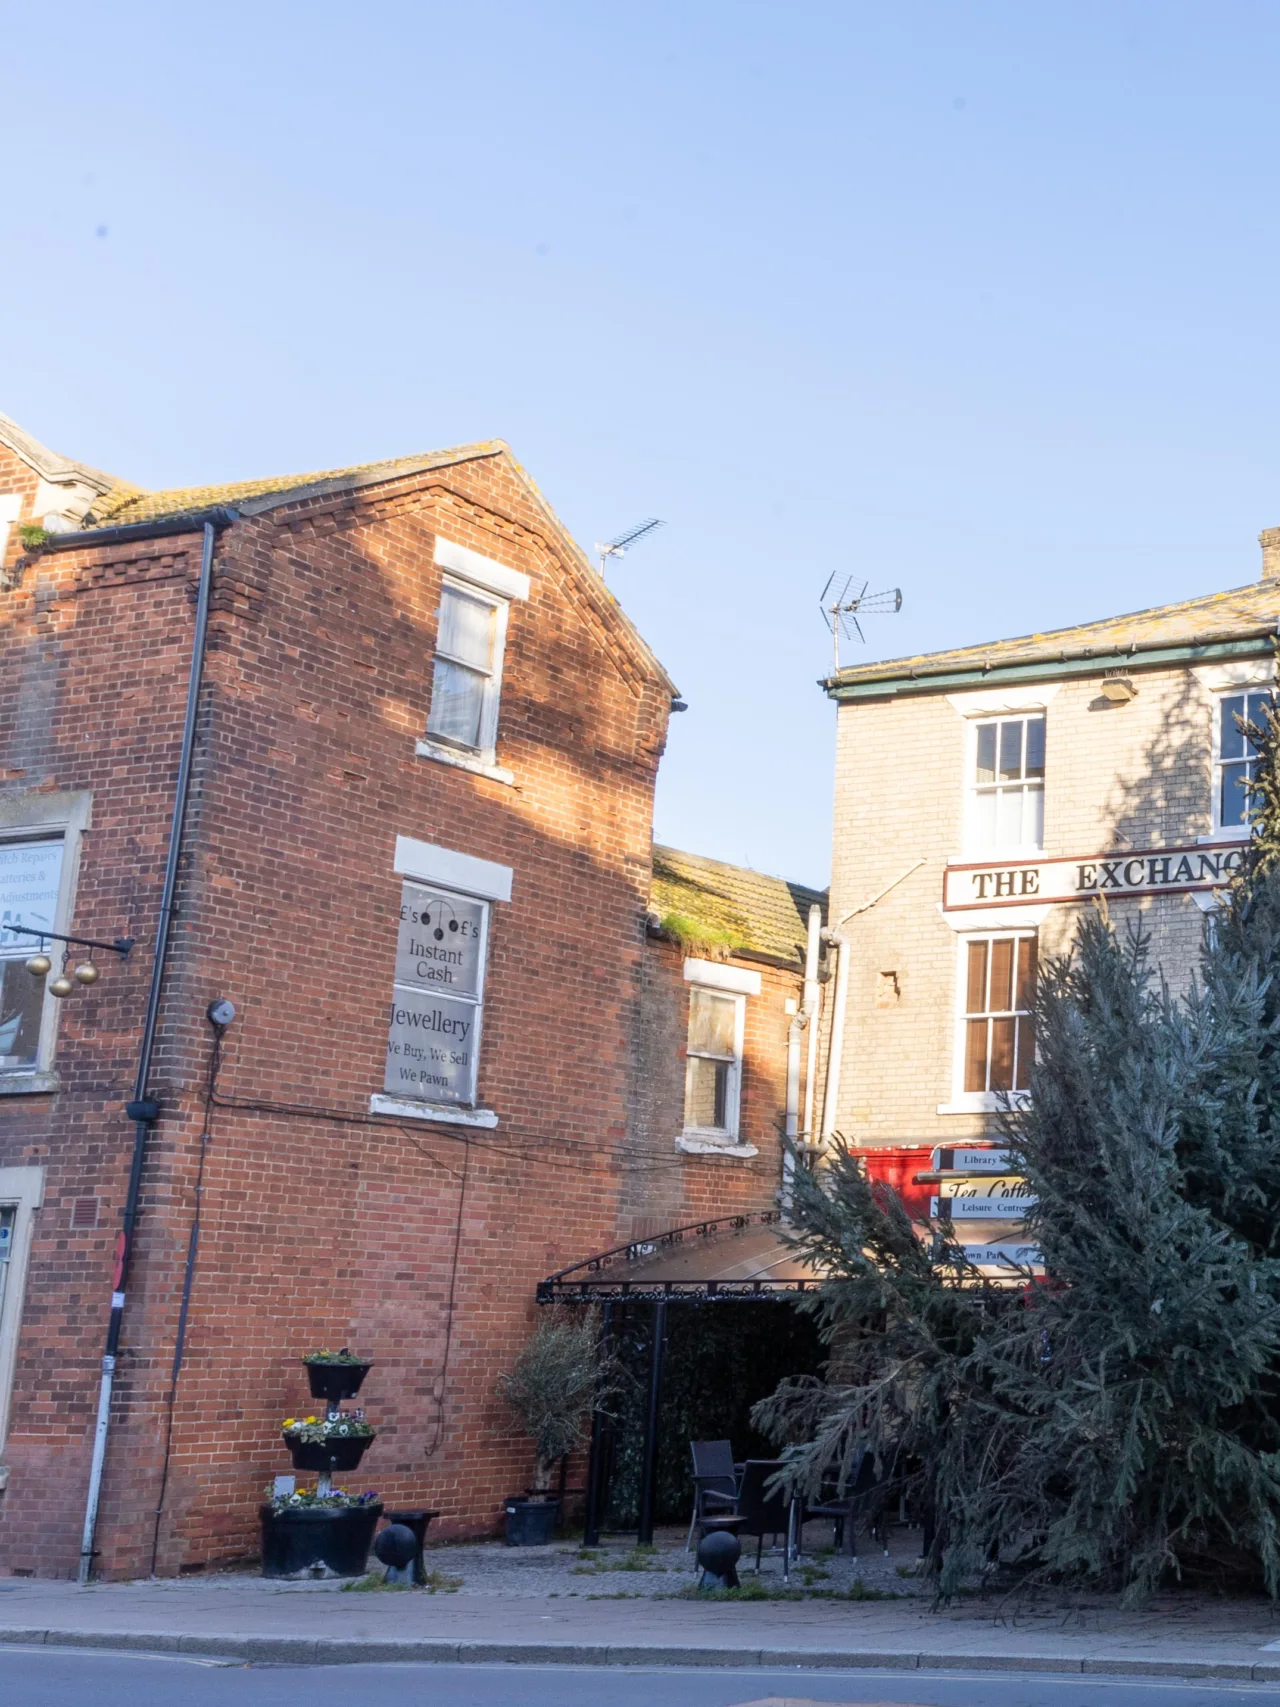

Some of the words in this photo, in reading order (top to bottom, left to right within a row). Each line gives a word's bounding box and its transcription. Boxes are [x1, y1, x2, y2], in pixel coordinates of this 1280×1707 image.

[21, 851, 57, 866] Repairs
[38, 870, 46, 881] &
[972, 869, 1039, 899] THE
[1, 889, 59, 905] Adjustments
[460, 920, 479, 939] £'s
[409, 938, 464, 966] Instant
[416, 961, 453, 984] Cash
[389, 1003, 471, 1042] Jewellery
[403, 1043, 427, 1062] Buy,
[430, 1047, 447, 1062] We
[449, 1051, 468, 1066] Sell
[400, 1067, 417, 1082] We
[420, 1070, 449, 1087] Pawn
[963, 1155, 998, 1166] Library
[949, 1180, 978, 1198] Tea
[961, 1203, 993, 1212] Leisure
[997, 1203, 1025, 1212] Centre
[964, 1252, 982, 1260] own
